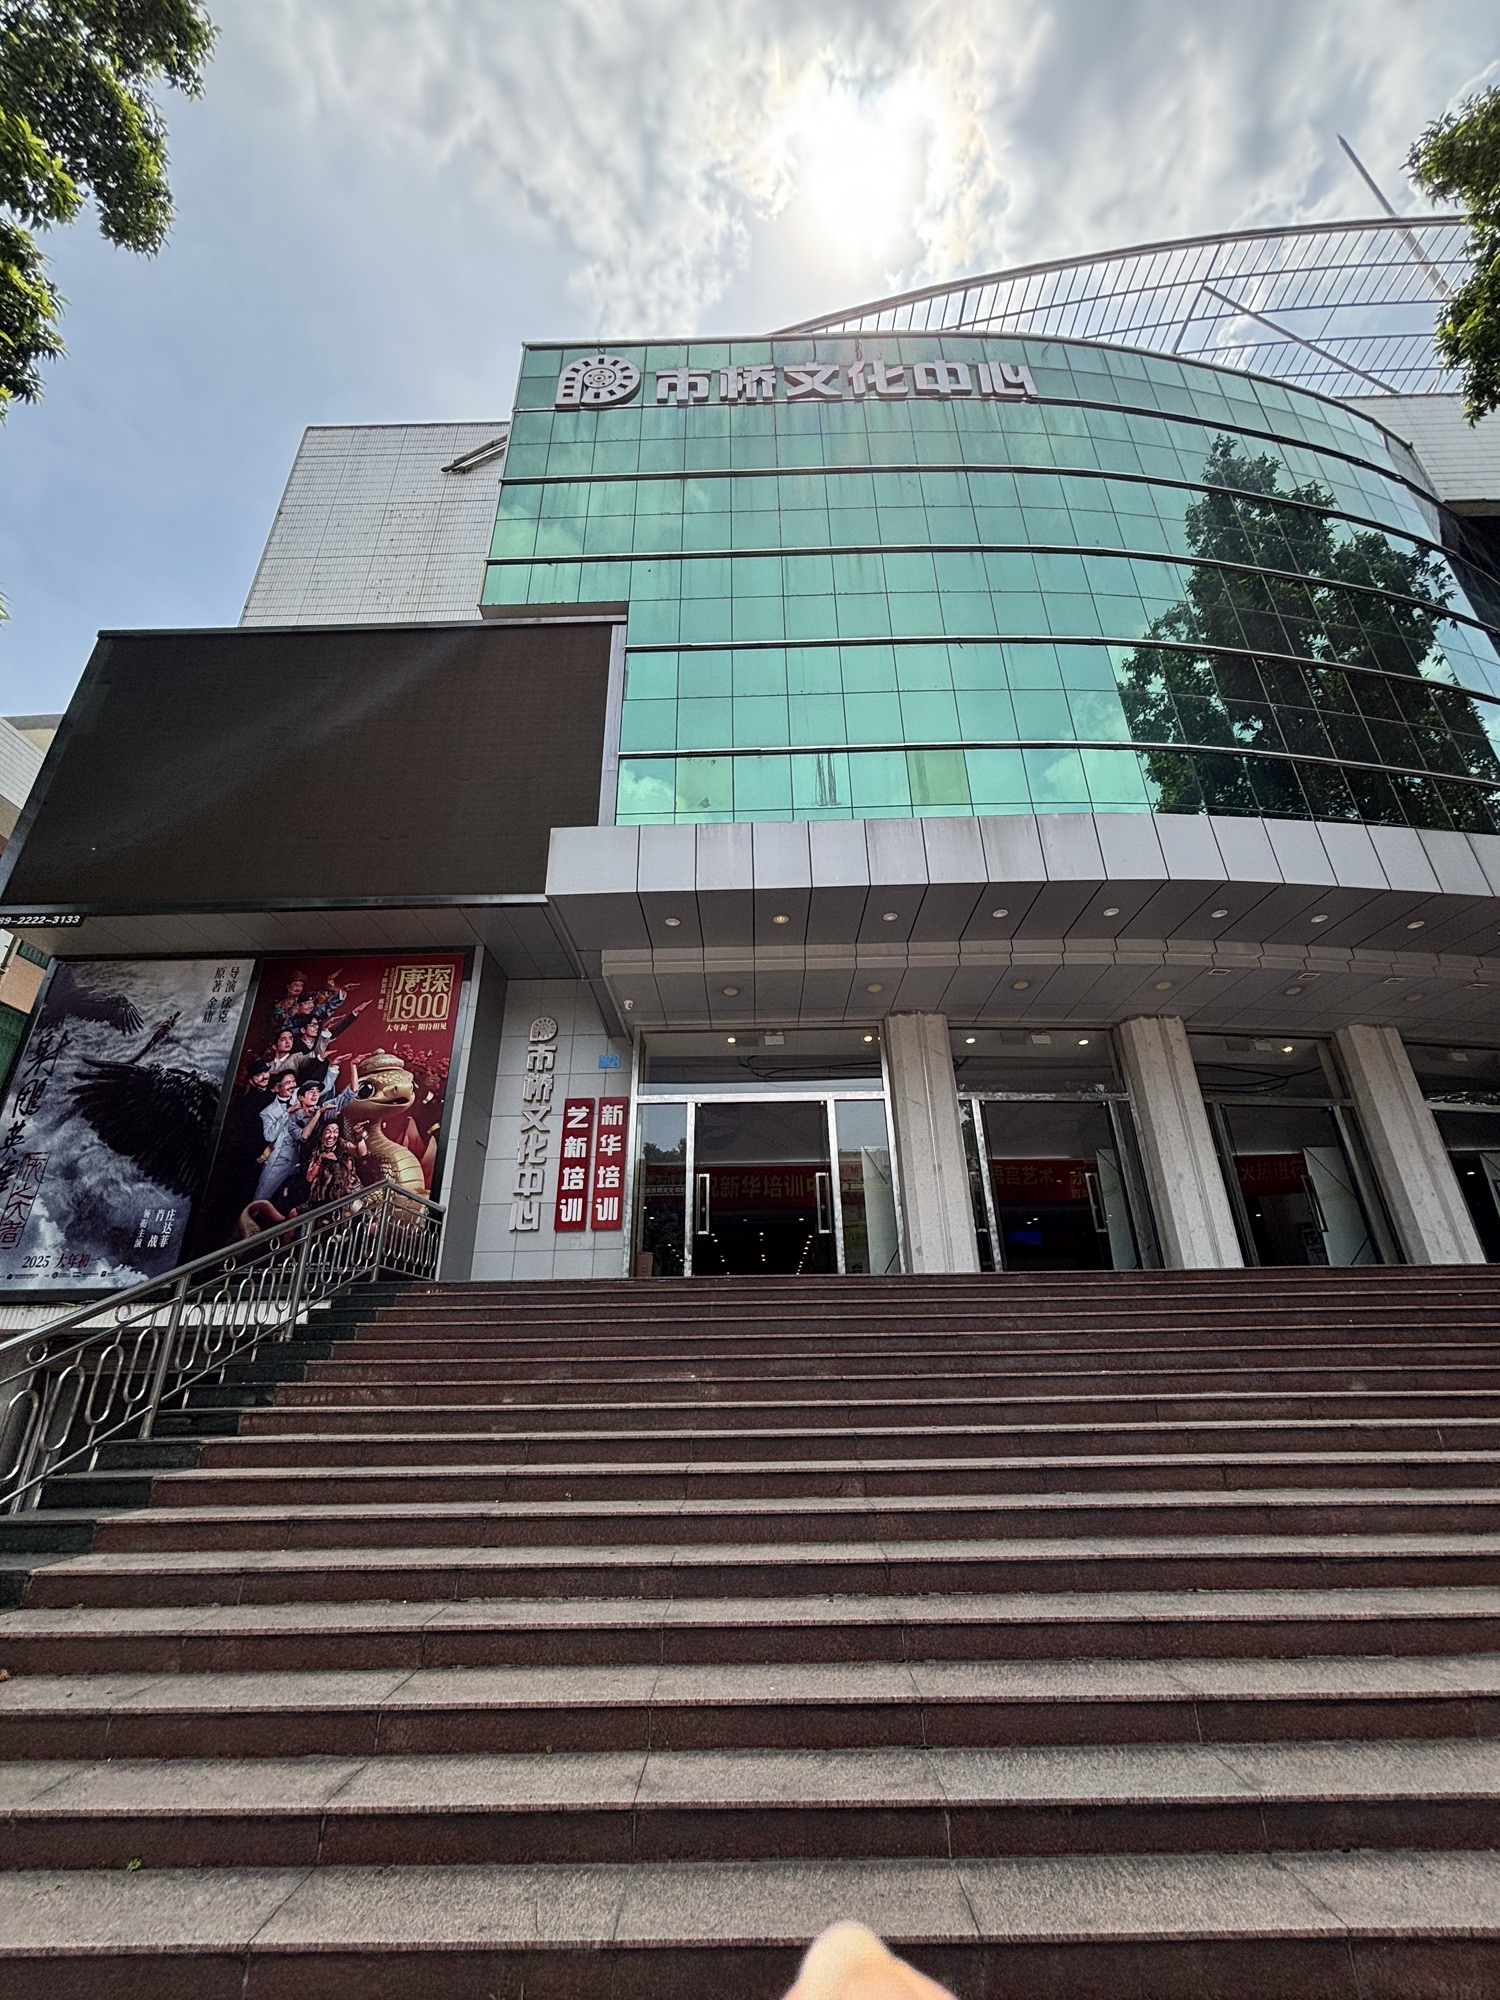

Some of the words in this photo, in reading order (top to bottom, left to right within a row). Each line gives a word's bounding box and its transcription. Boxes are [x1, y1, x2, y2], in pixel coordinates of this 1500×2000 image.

[656, 360, 1038, 405] 市桥文化中心
[210, 966, 227, 993] 原著
[225, 966, 240, 993] 导演
[394, 968, 452, 994] 唐探
[218, 996, 233, 1023] 徐克
[391, 993, 448, 1020] 1900
[508, 1044, 558, 1231] 市桥文化中心
[559, 1106, 590, 1222] 艺新培训
[596, 1104, 623, 1221] 新华培训
[147, 1208, 166, 1248] 肖战
[159, 1208, 177, 1248] 庄达菲
[21, 1255, 52, 1269] 2025
[54, 1252, 101, 1269] 大年初一
